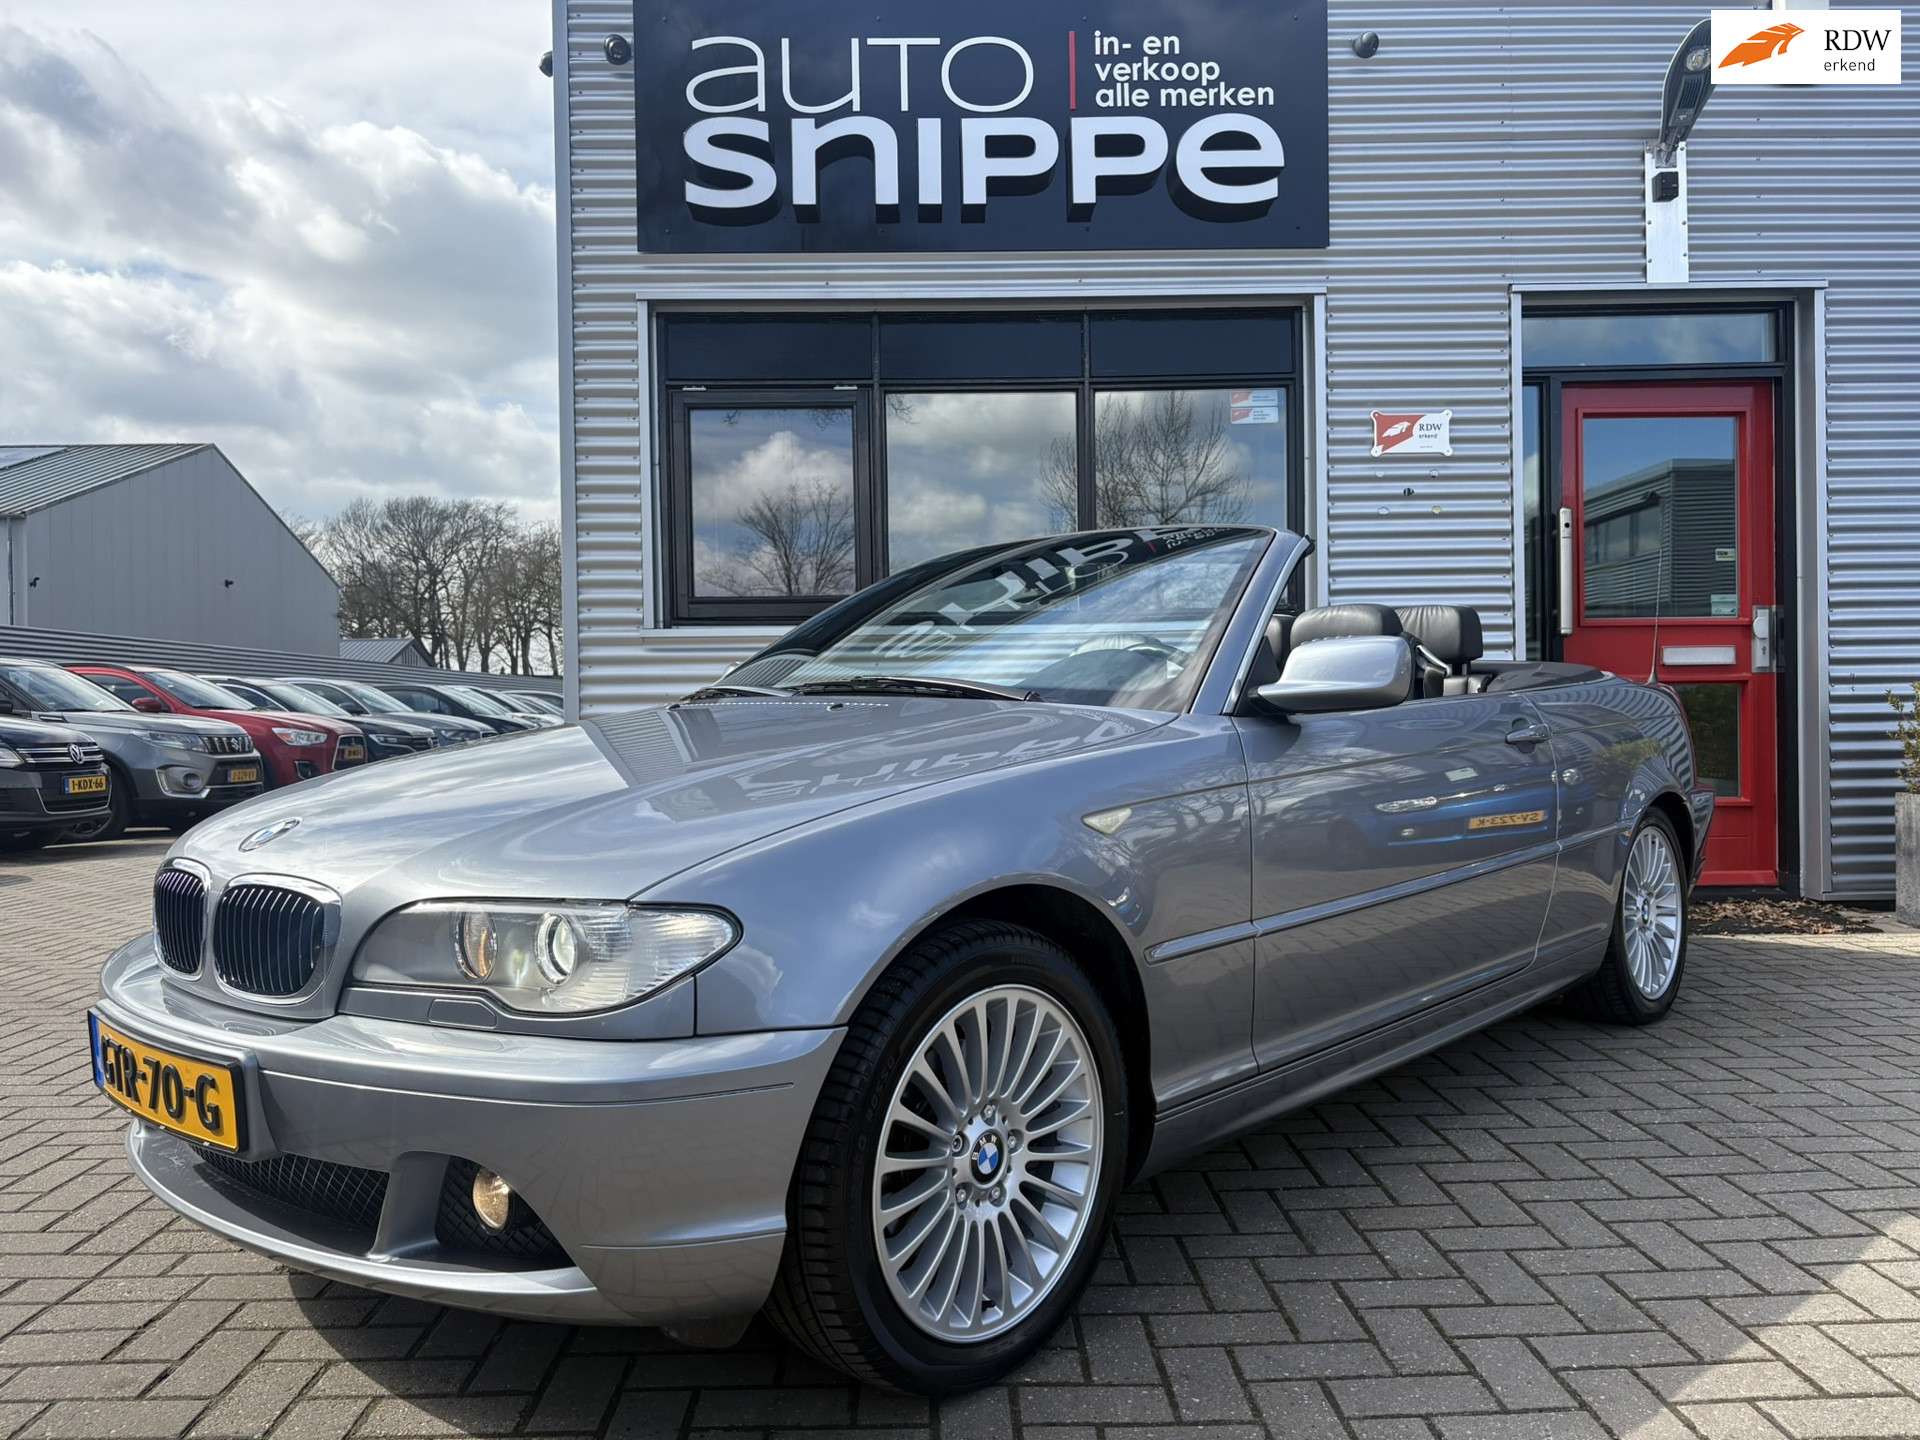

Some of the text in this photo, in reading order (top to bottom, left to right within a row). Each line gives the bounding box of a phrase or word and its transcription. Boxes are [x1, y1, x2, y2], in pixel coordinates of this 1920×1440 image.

[1094, 30, 1180, 55] in- en
[1094, 56, 1220, 86] verkoop
[1095, 81, 1275, 107] alle merken
[1418, 423, 1442, 432] RDW
[971, 1134, 998, 1161] BMW
